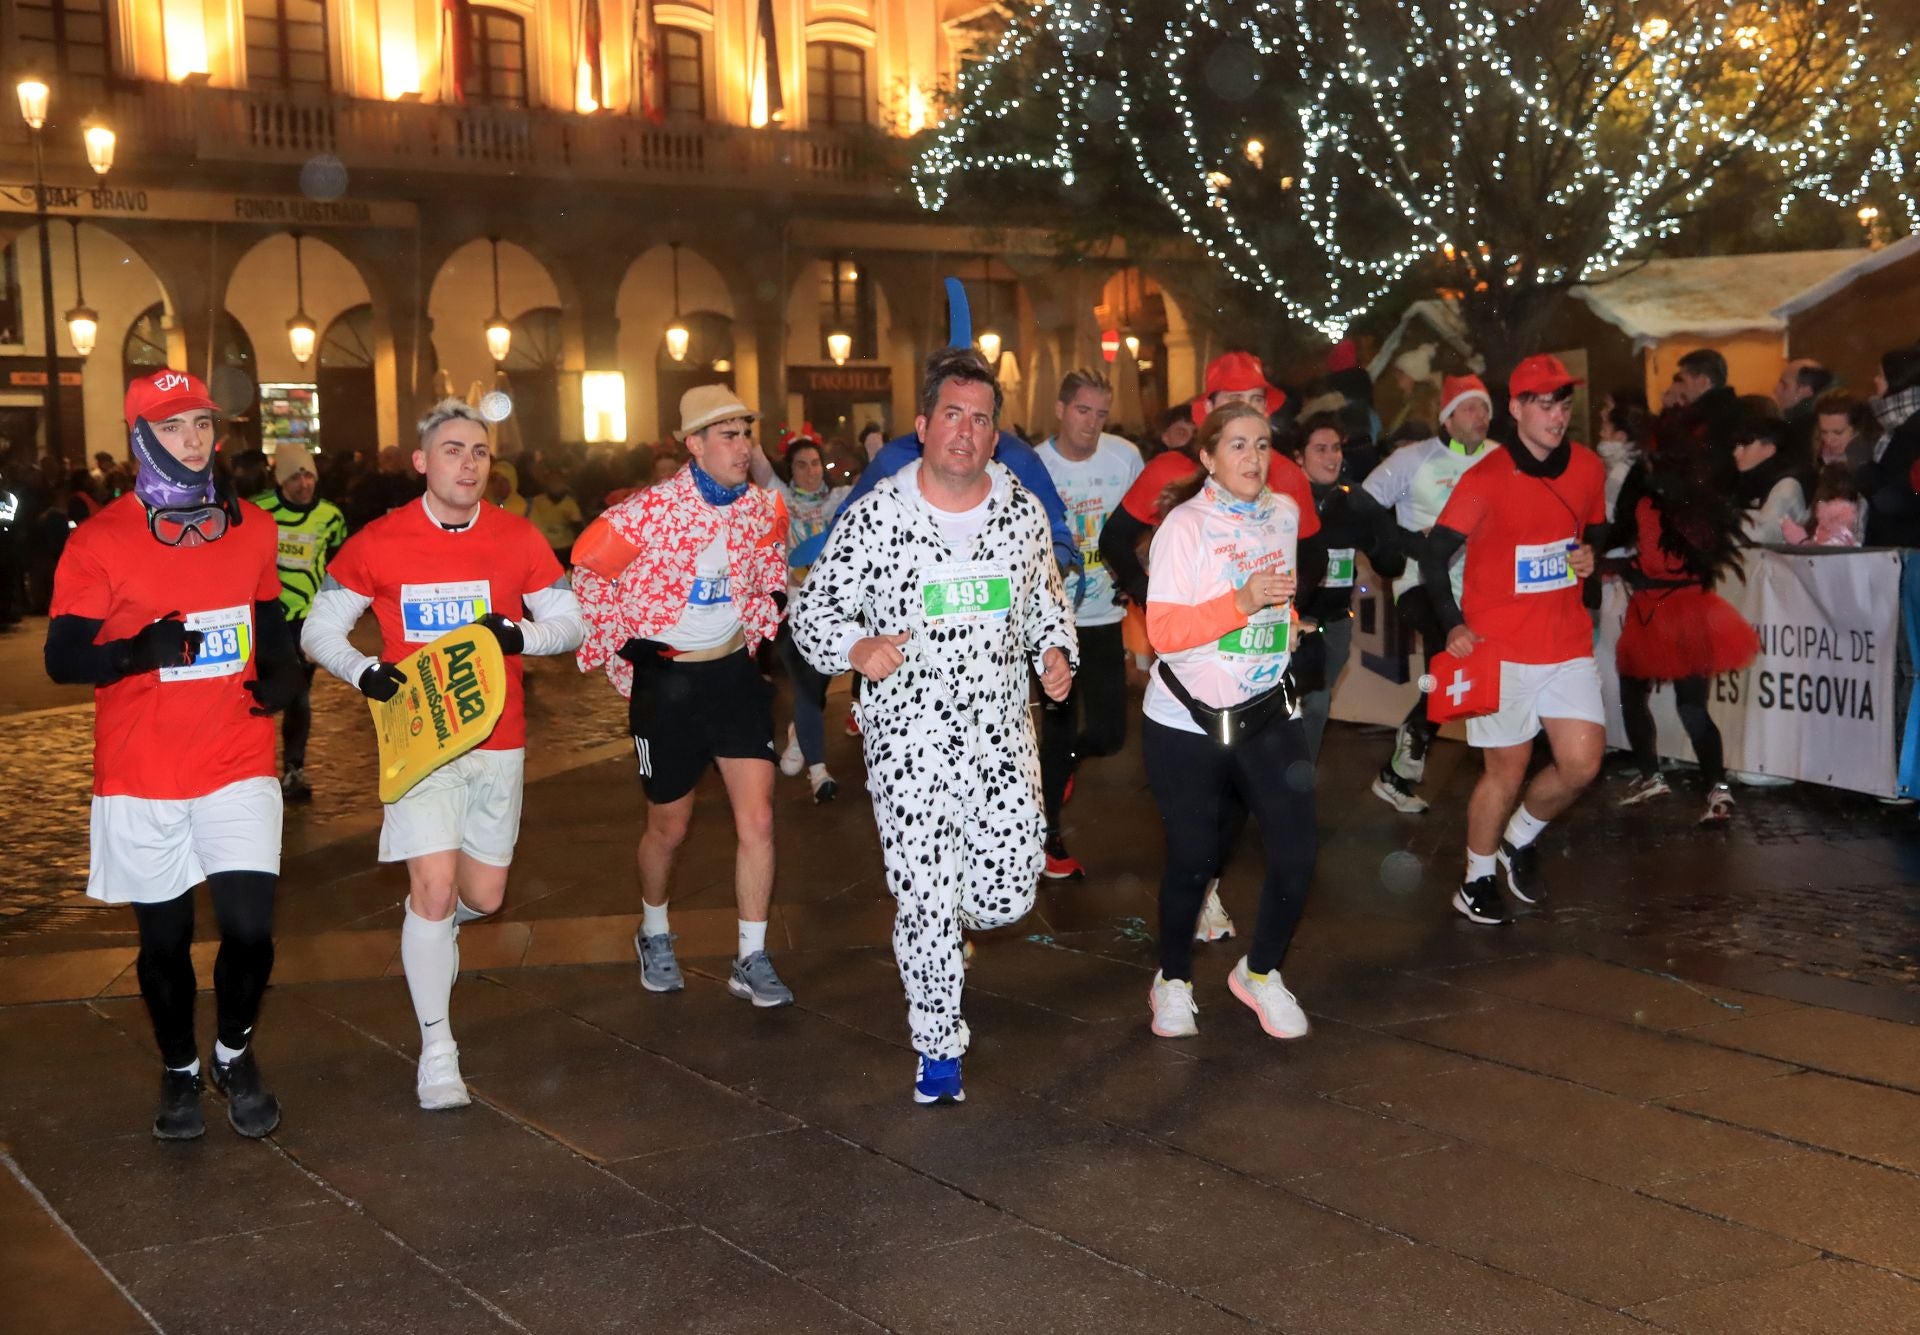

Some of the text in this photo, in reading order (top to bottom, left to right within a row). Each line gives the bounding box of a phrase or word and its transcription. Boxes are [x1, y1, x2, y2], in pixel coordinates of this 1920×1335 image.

[92, 188, 149, 212] BRAVO
[234, 197, 286, 220] FONDA
[154, 374, 190, 392] EDM
[1227, 551, 1248, 562] SAN
[1237, 548, 1285, 573] SILVESTRE
[1529, 556, 1567, 579] 3195
[946, 580, 989, 607] 493
[420, 601, 474, 625] 3194
[199, 629, 237, 658] 193
[1239, 626, 1274, 649] 606
[1850, 629, 1876, 664] DE
[442, 640, 486, 726] Aqua
[416, 654, 452, 741] SwimSchool
[1758, 670, 1875, 721] SEGOVIA
